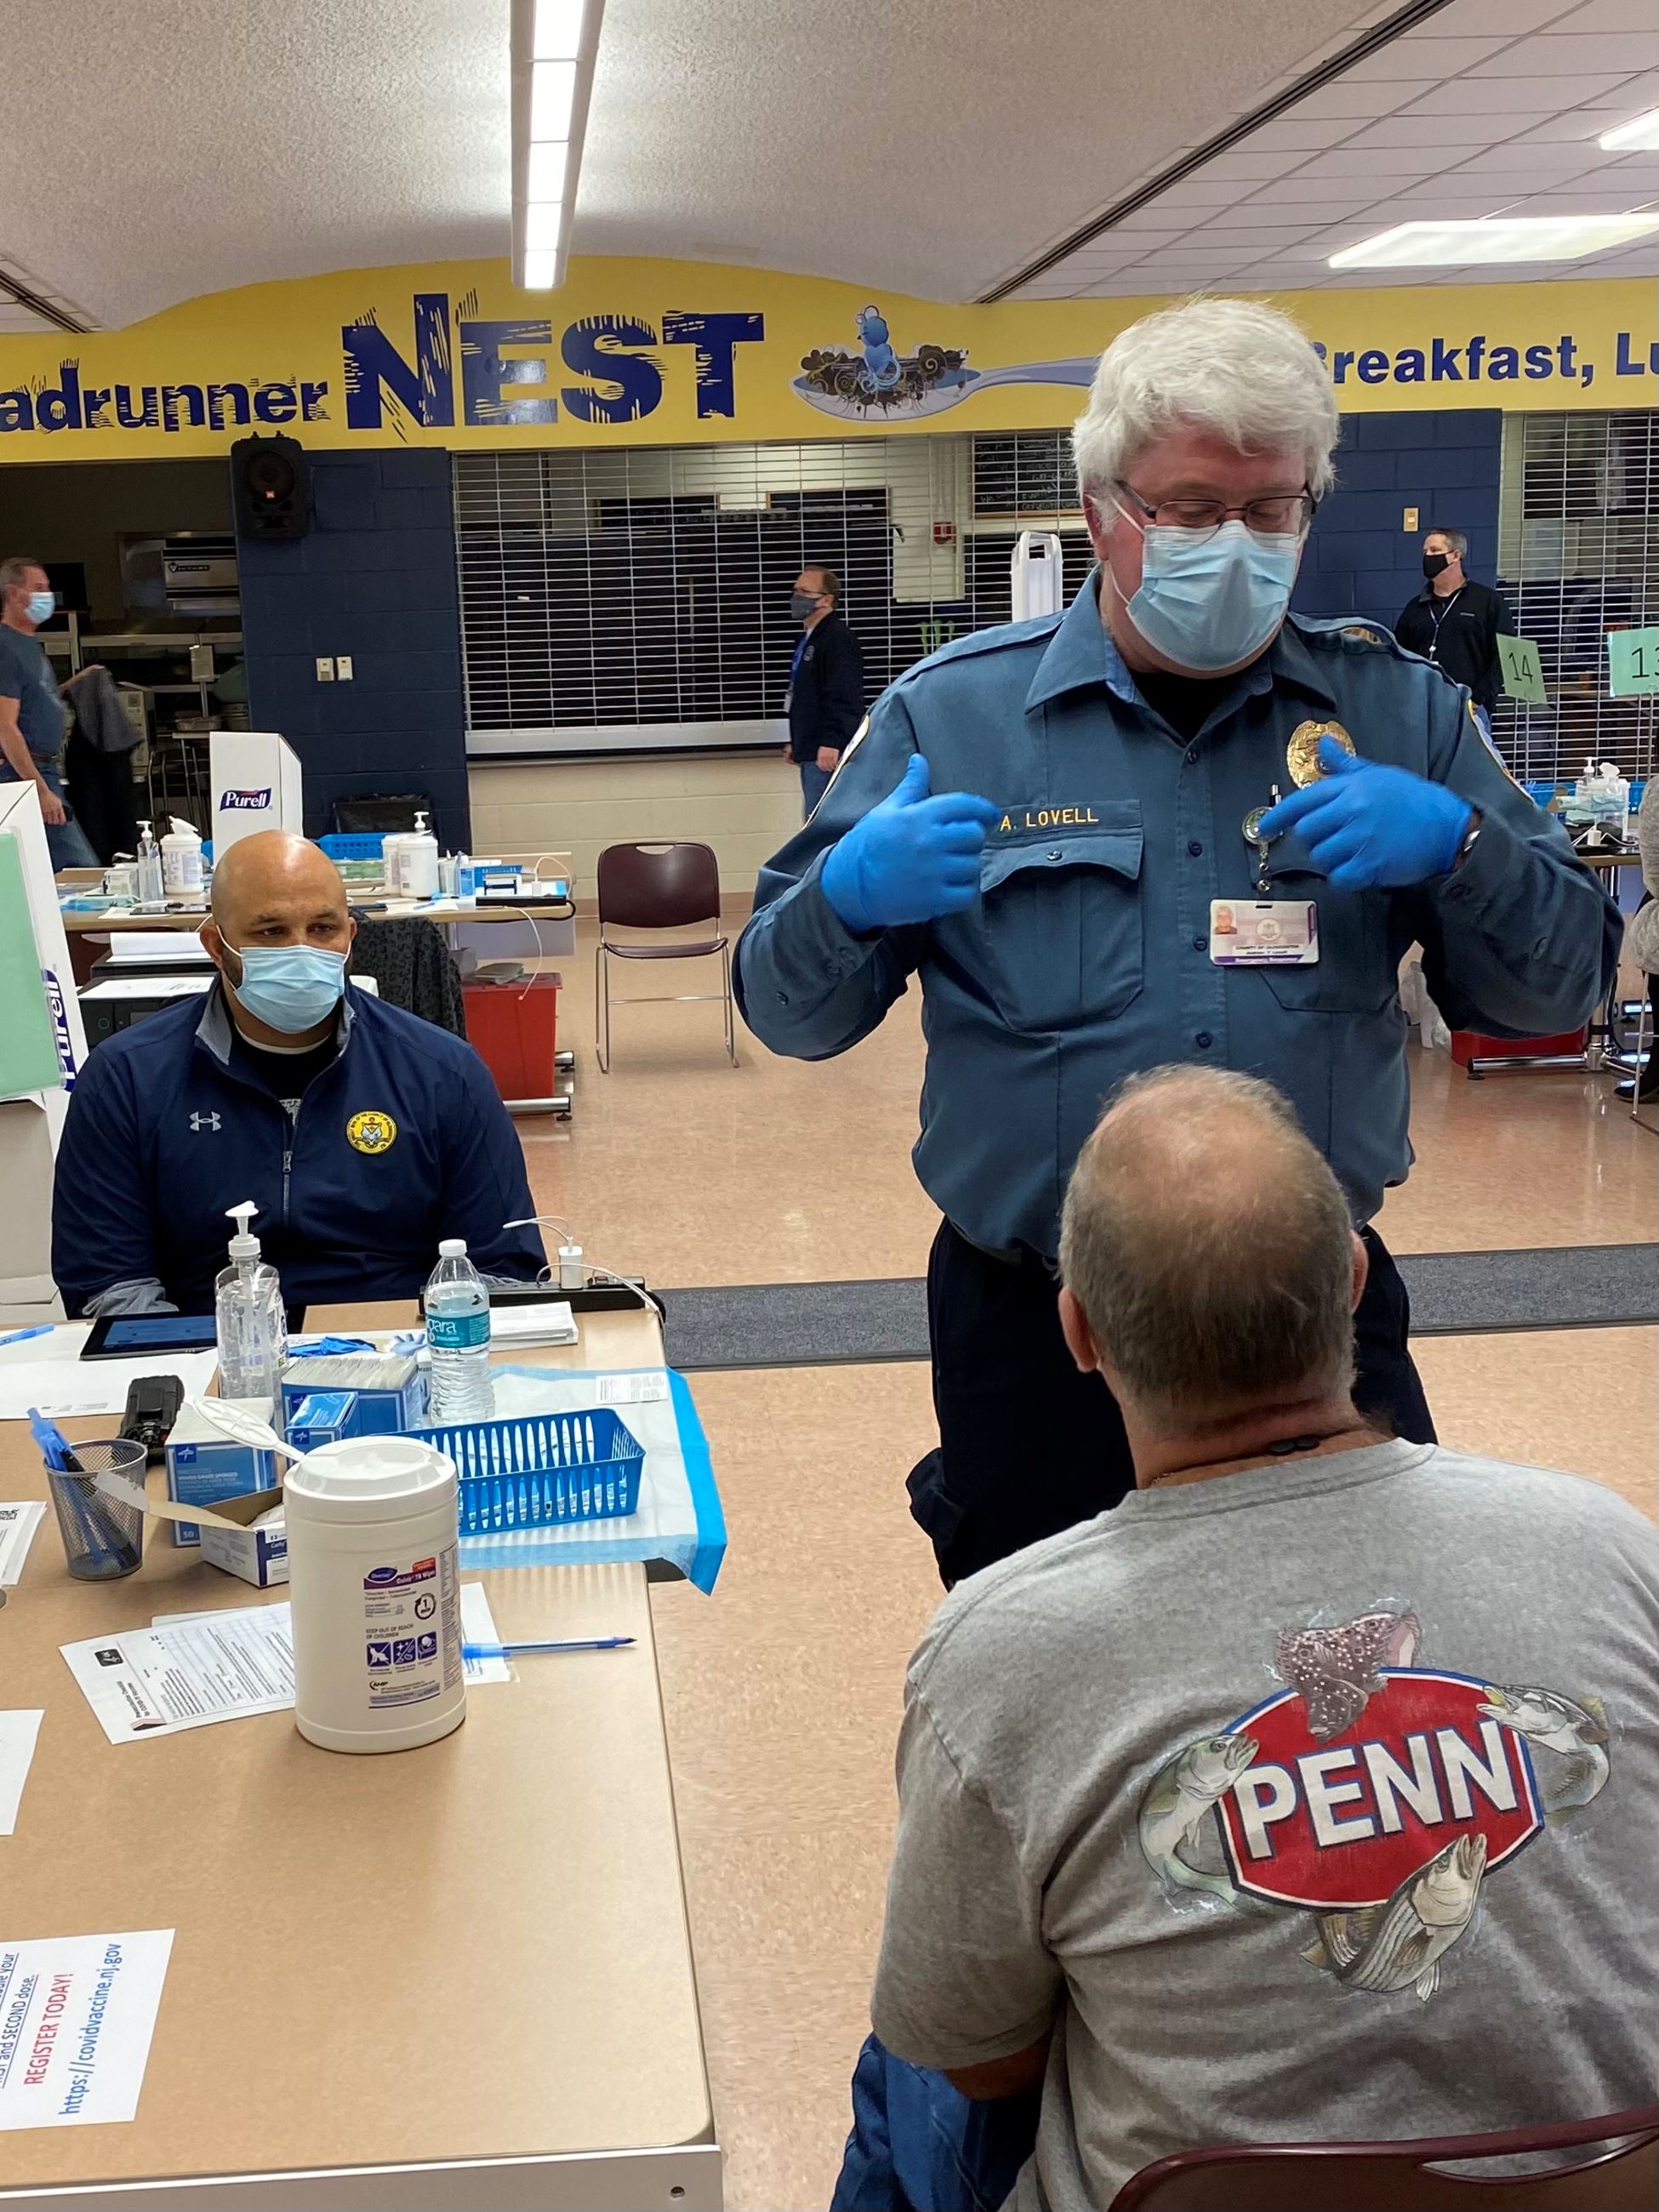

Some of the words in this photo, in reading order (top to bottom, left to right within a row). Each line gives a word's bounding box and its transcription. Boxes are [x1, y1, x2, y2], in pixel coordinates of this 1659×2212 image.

[341, 293, 765, 430] NEST
[1616, 332, 1659, 376] L
[1508, 652, 1533, 684] 14
[225, 791, 267, 807] Purell
[1000, 815, 1017, 831] A.
[1026, 807, 1099, 827] LOVELL
[1232, 1719, 1519, 1860] PENN
[1, 1953, 14, 1973] your
[17, 1975, 35, 1999] dose.
[2, 2001, 26, 2039] SECOND
[24, 2023, 60, 2084] REGISTER
[43, 1974, 74, 2021] TODAY!
[58, 1943, 123, 2115] https://covidvaccine.nj.gov
[0, 2042, 13, 2060] and
